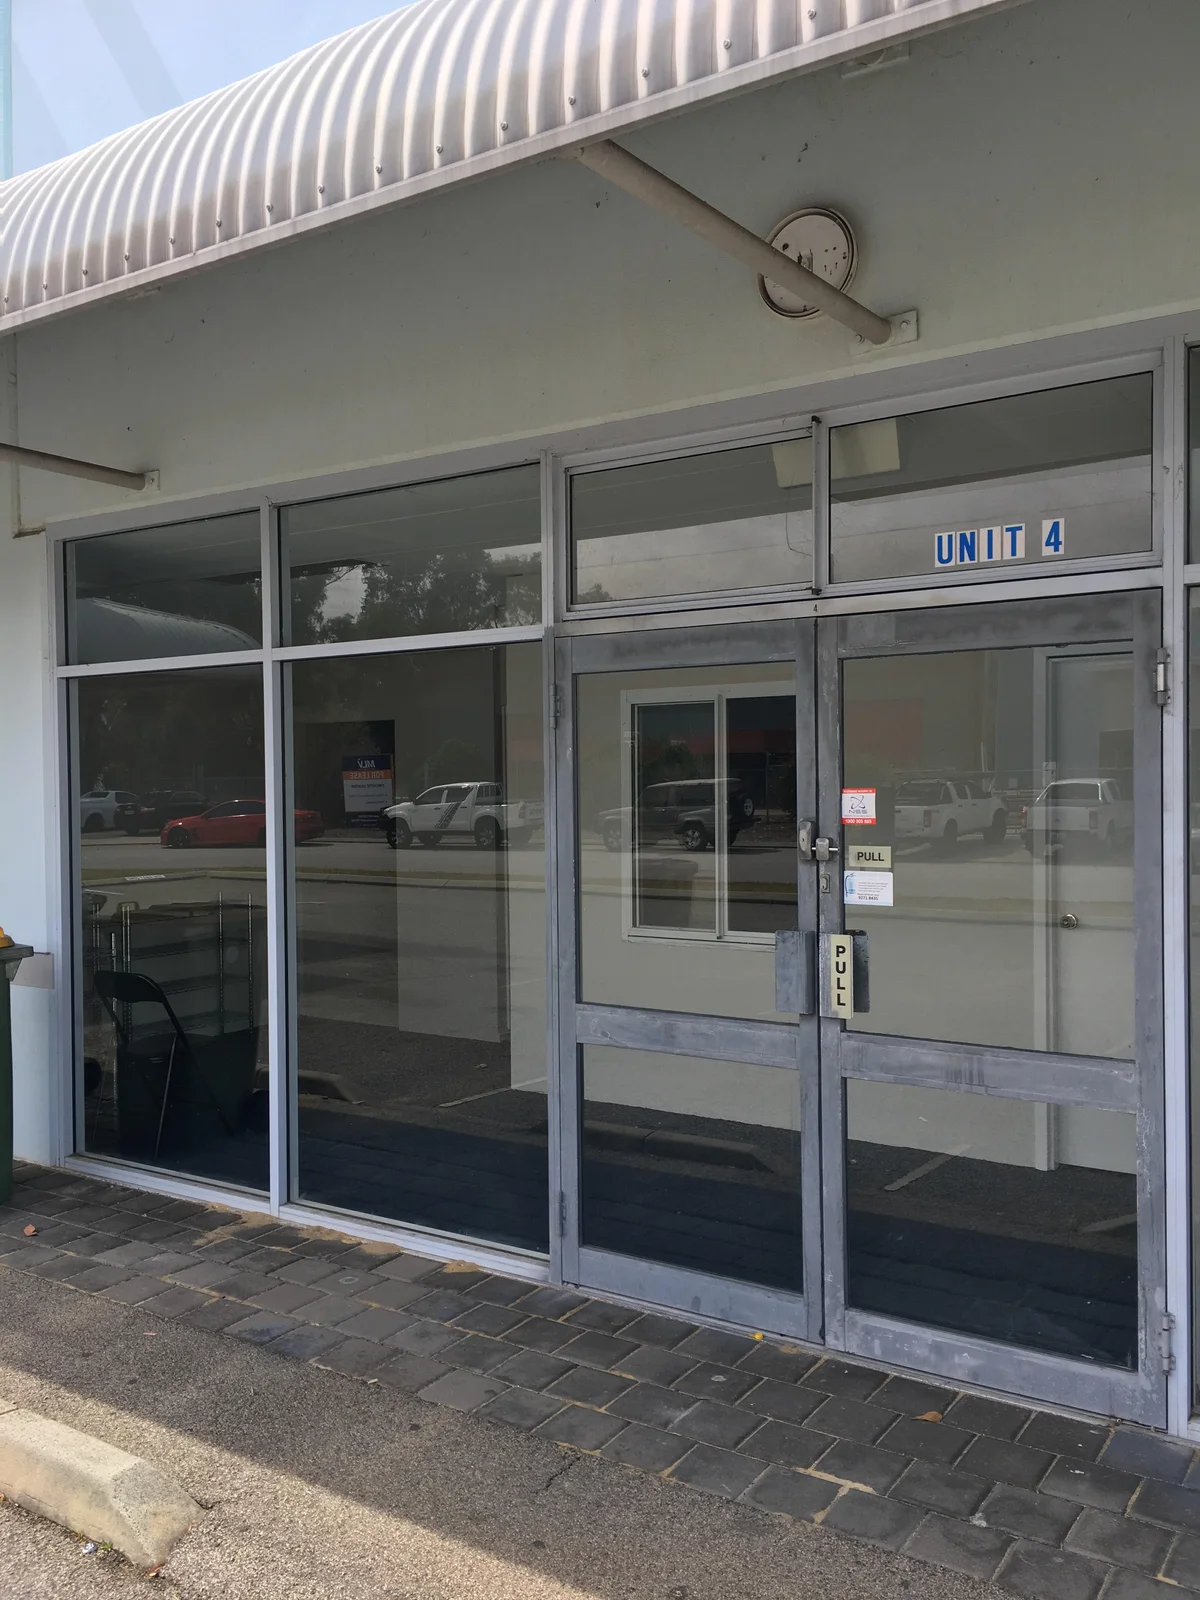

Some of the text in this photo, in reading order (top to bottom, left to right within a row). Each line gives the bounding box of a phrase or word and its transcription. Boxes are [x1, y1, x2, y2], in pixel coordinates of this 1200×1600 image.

[936, 520, 1063, 565] UNIT 4
[857, 851, 885, 862] PULL
[835, 945, 846, 1007] PULL
